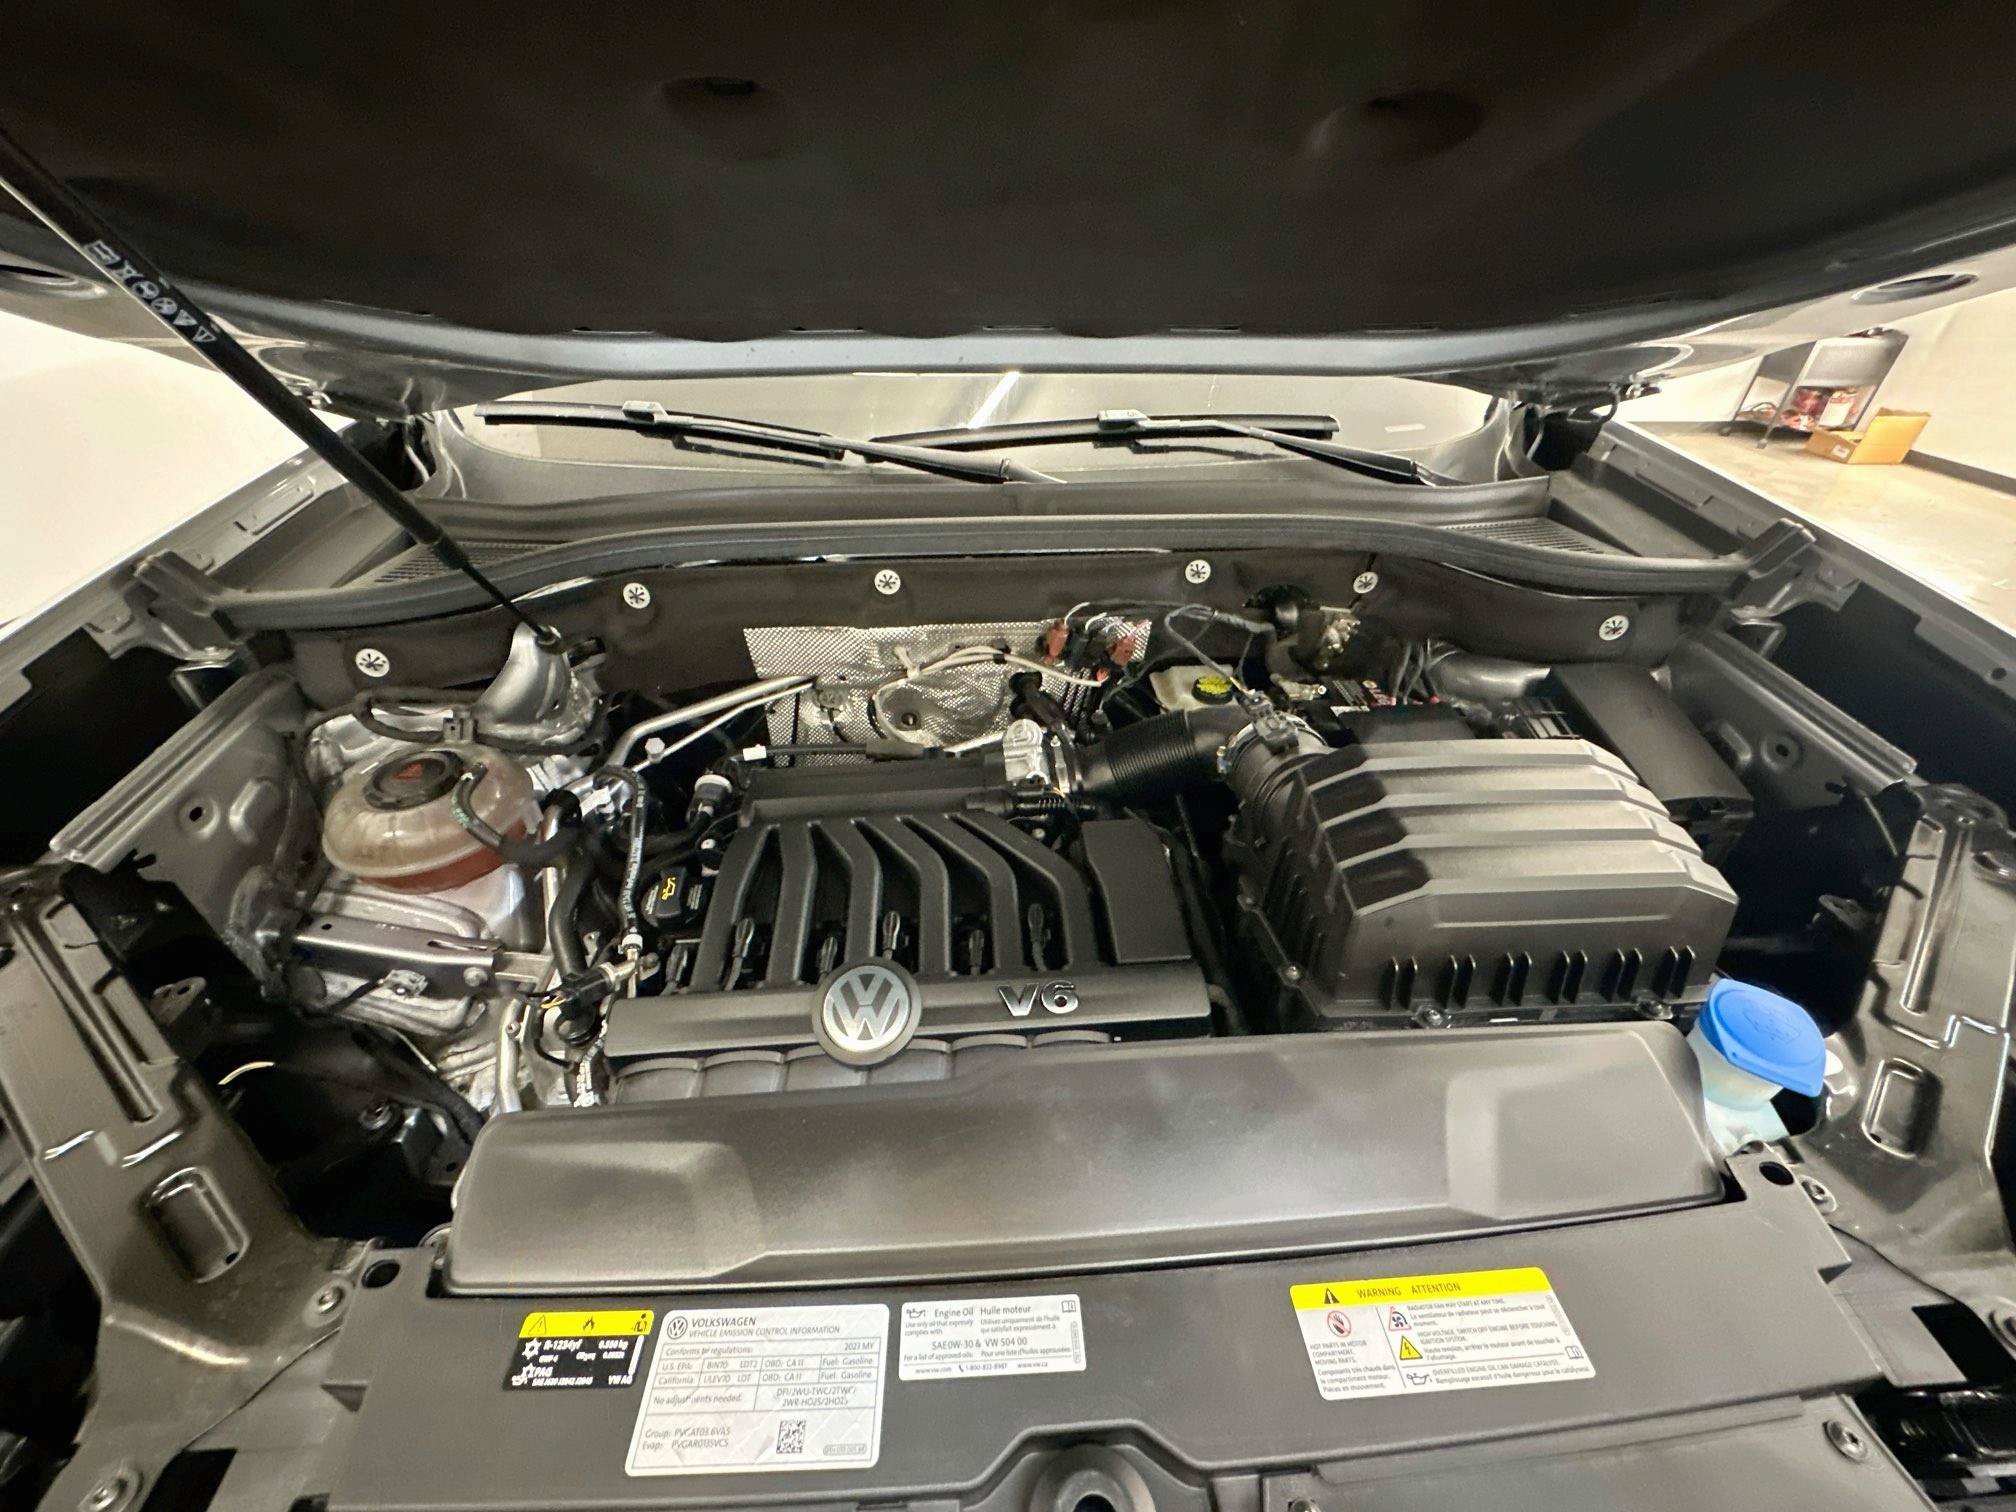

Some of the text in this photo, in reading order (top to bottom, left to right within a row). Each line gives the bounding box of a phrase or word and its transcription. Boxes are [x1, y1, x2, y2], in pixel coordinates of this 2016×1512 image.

[998, 979, 1079, 1016] V6
[1357, 1283, 1461, 1298] WARNING ATTENTION
[934, 1307, 974, 1318] Engine Oil
[980, 1305, 1031, 1314] Huile moteur
[691, 1316, 756, 1326] VOLKSWAGEN
[755, 1327, 787, 1335] CONTROL
[790, 1326, 839, 1334] INFORMATION
[844, 1342, 860, 1350] 2023
[931, 1341, 947, 1350] SAE
[975, 1339, 980, 1347] &
[985, 1338, 999, 1346] VW
[1000, 1337, 1015, 1345] 504
[1017, 1336, 1027, 1344] 00
[665, 1347, 700, 1355] Conforms
[842, 1356, 872, 1364] Gasoline
[535, 1367, 553, 1377] PAG
[841, 1370, 871, 1379] Gasoline
[608, 1375, 633, 1385] VW AG
[653, 1396, 664, 1404] No
[644, 1428, 671, 1439] Group:
